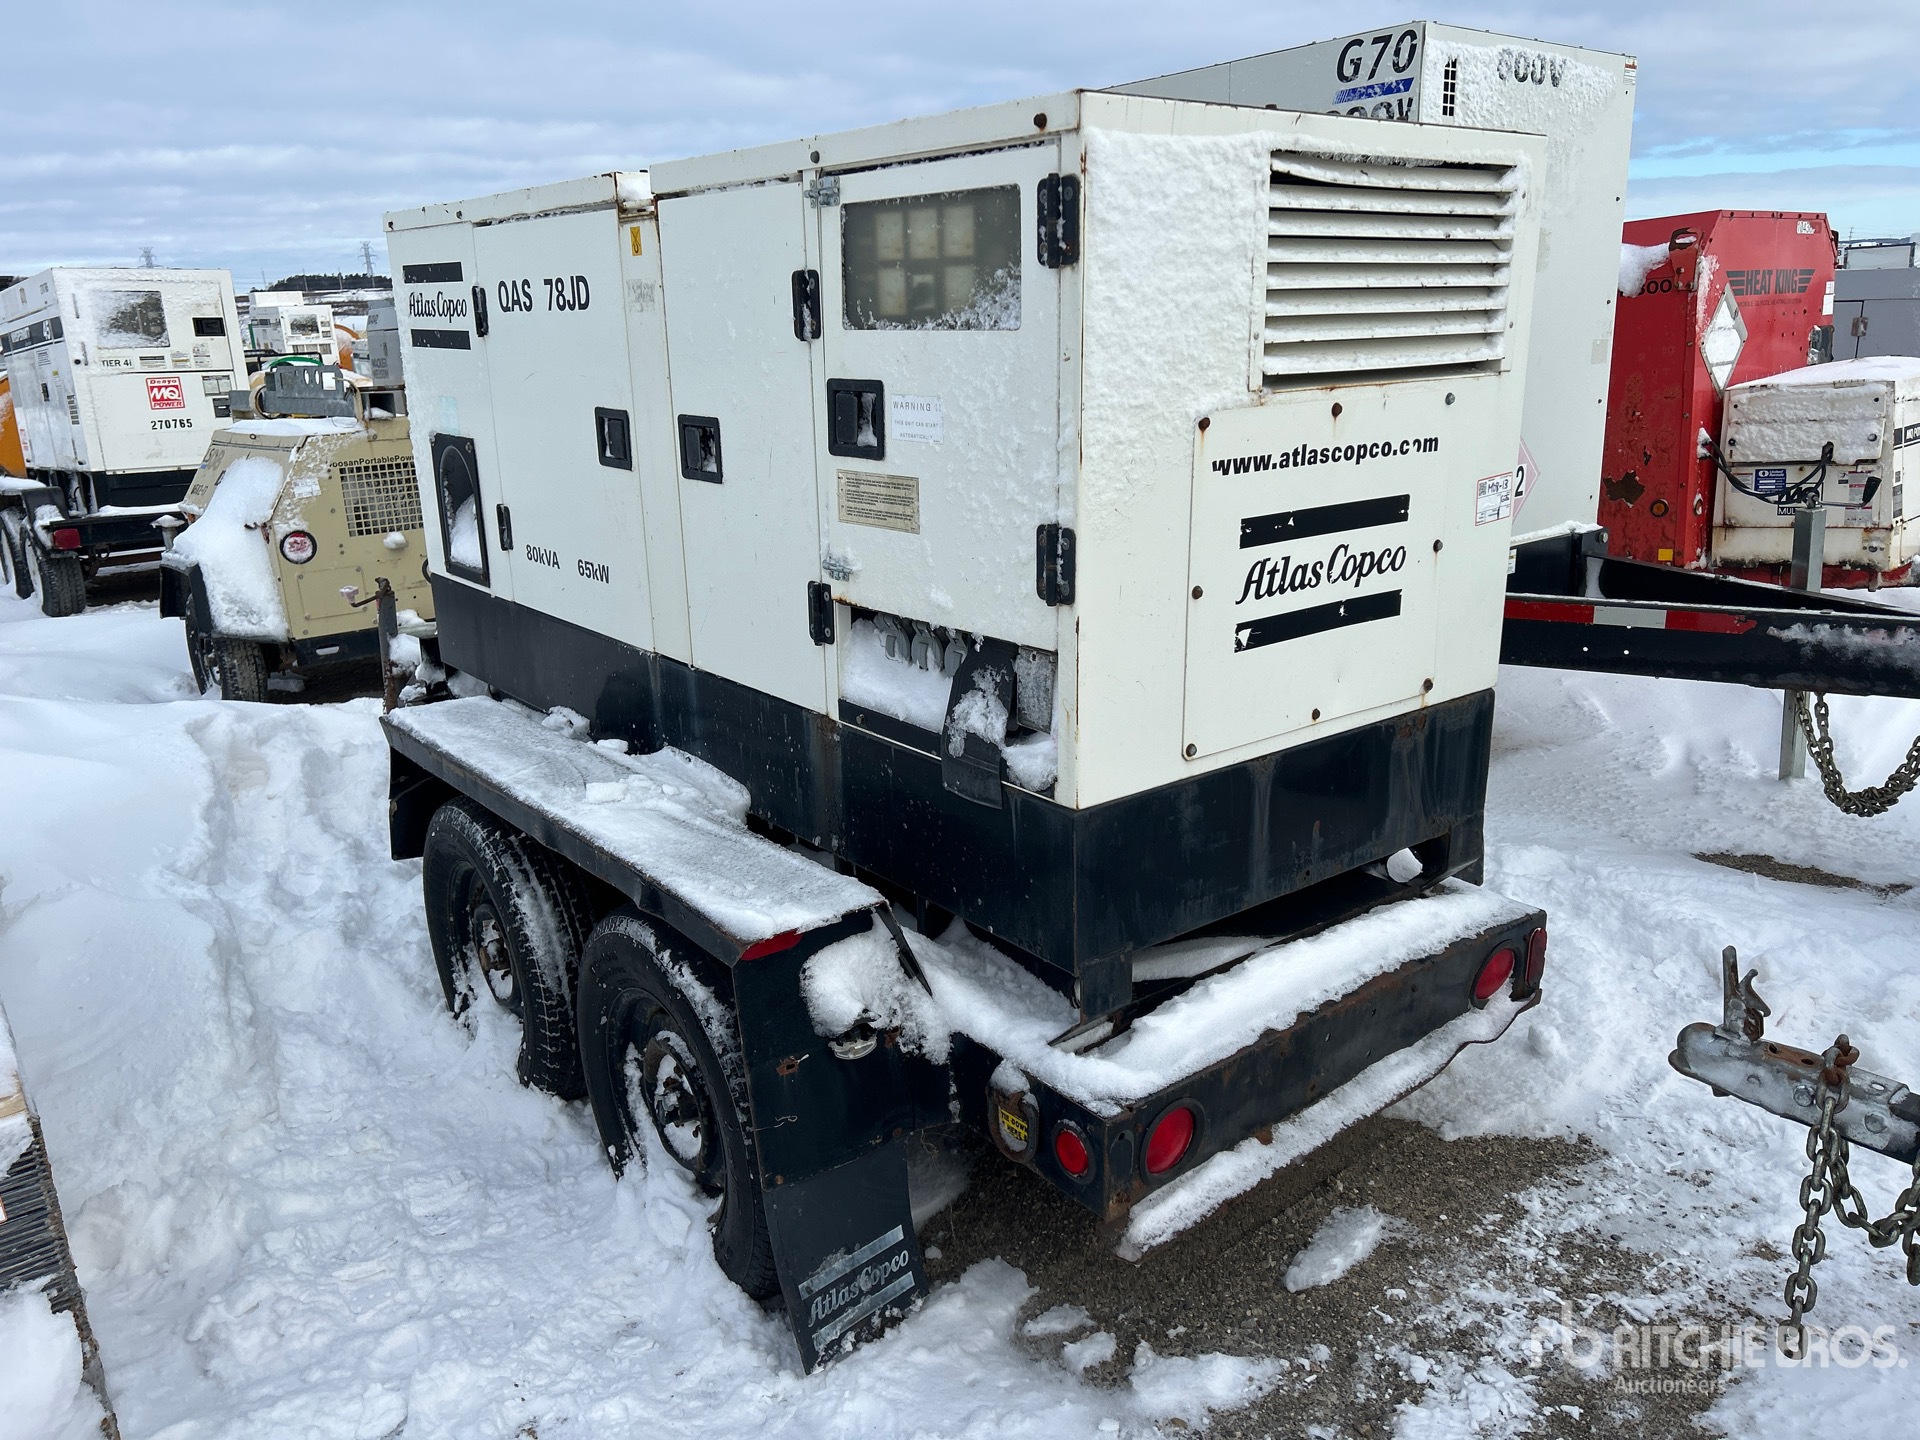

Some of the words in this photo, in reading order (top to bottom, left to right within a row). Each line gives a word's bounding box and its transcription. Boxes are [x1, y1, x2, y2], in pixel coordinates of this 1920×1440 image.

[1336, 29, 1418, 83] G70
[497, 278, 533, 313] QAS
[543, 275, 590, 312] 78JD
[1745, 269, 1773, 296] HEAT
[1774, 268, 1798, 294] KING
[437, 290, 467, 324] Copco
[150, 386, 182, 400] MQ
[892, 401, 931, 412] WARNING
[150, 418, 193, 431] 270765
[329, 454, 415, 468] oosanPortablePow
[1514, 465, 1525, 498] 2
[526, 544, 560, 570] 80kVA
[577, 558, 609, 585] 65kW
[1235, 555, 1324, 605] Atlas
[1326, 543, 1407, 588] Copco
[808, 1283, 859, 1328] Atlas
[859, 1250, 909, 1293] Copco
